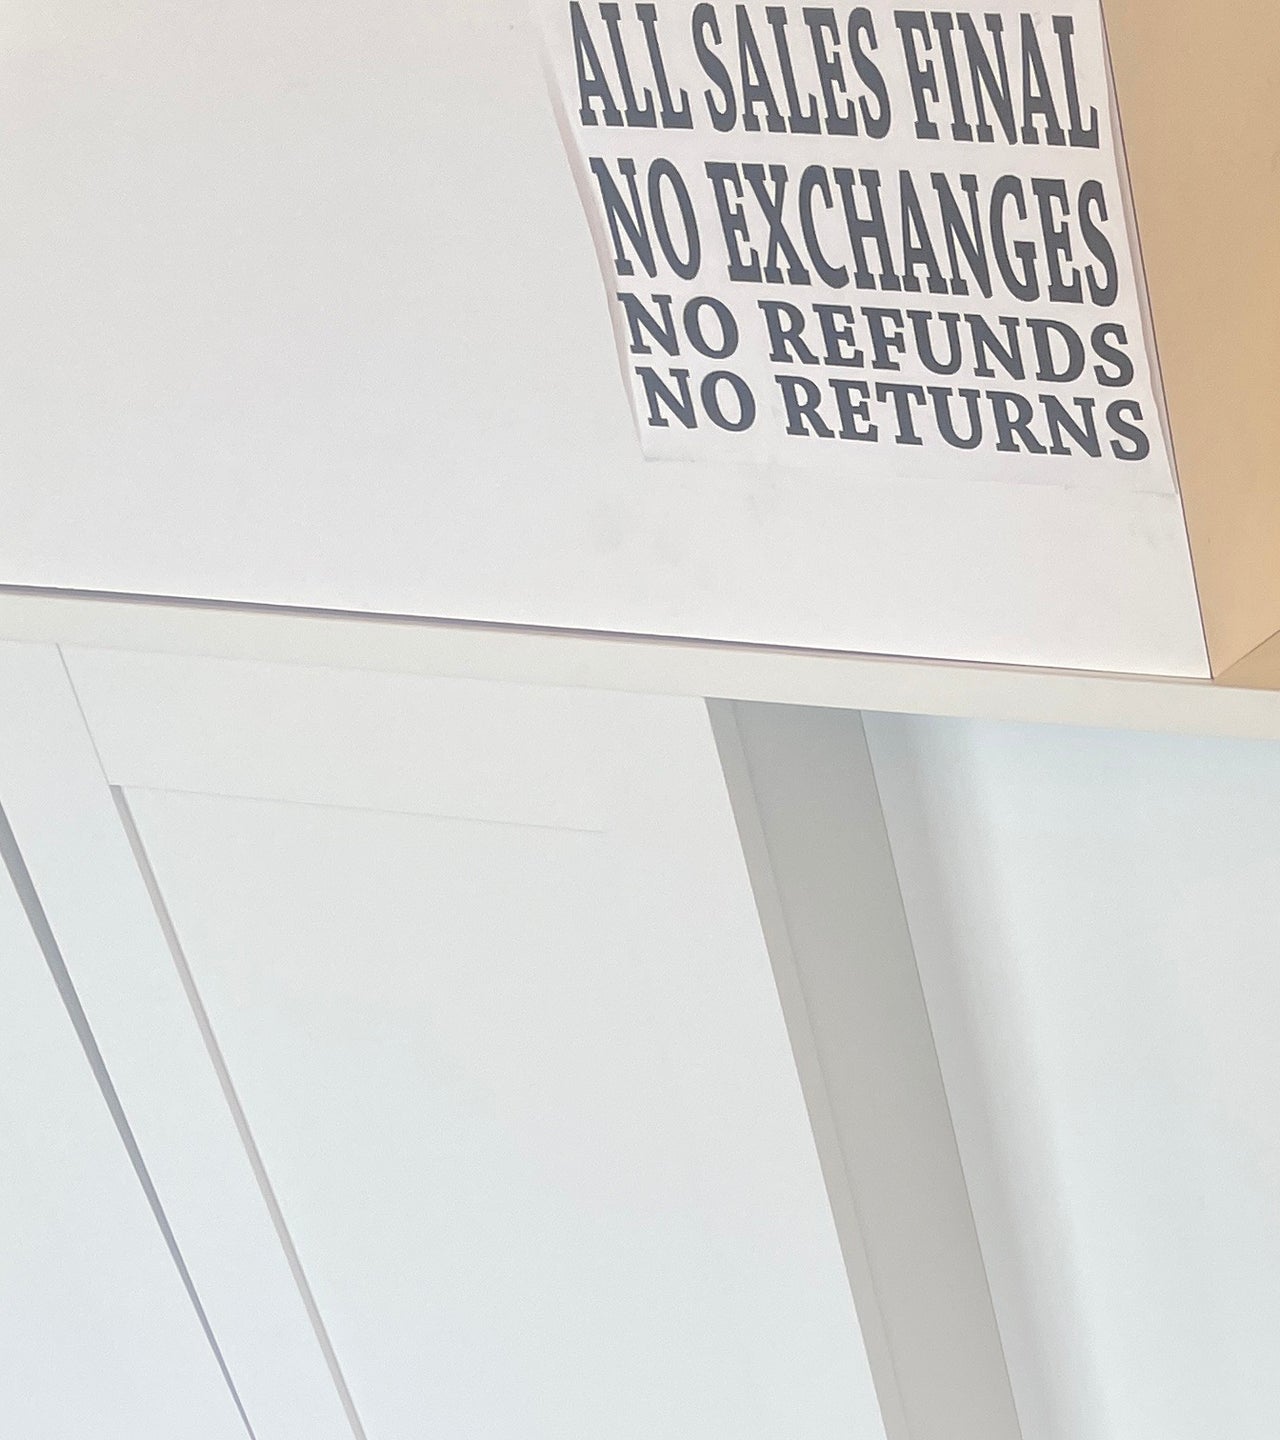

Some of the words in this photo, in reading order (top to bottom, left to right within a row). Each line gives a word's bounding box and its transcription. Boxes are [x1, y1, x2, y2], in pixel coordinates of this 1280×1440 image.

[569, 0, 694, 130] ALL
[691, 4, 892, 140] SALES
[893, 10, 1100, 150] FINAL
[588, 156, 701, 281] NO
[703, 161, 1119, 308] EXCHANGES
[616, 292, 739, 360] NO
[757, 299, 1135, 388] REFUNDS
[634, 366, 756, 432] NO
[774, 374, 1150, 461] RETURNS
